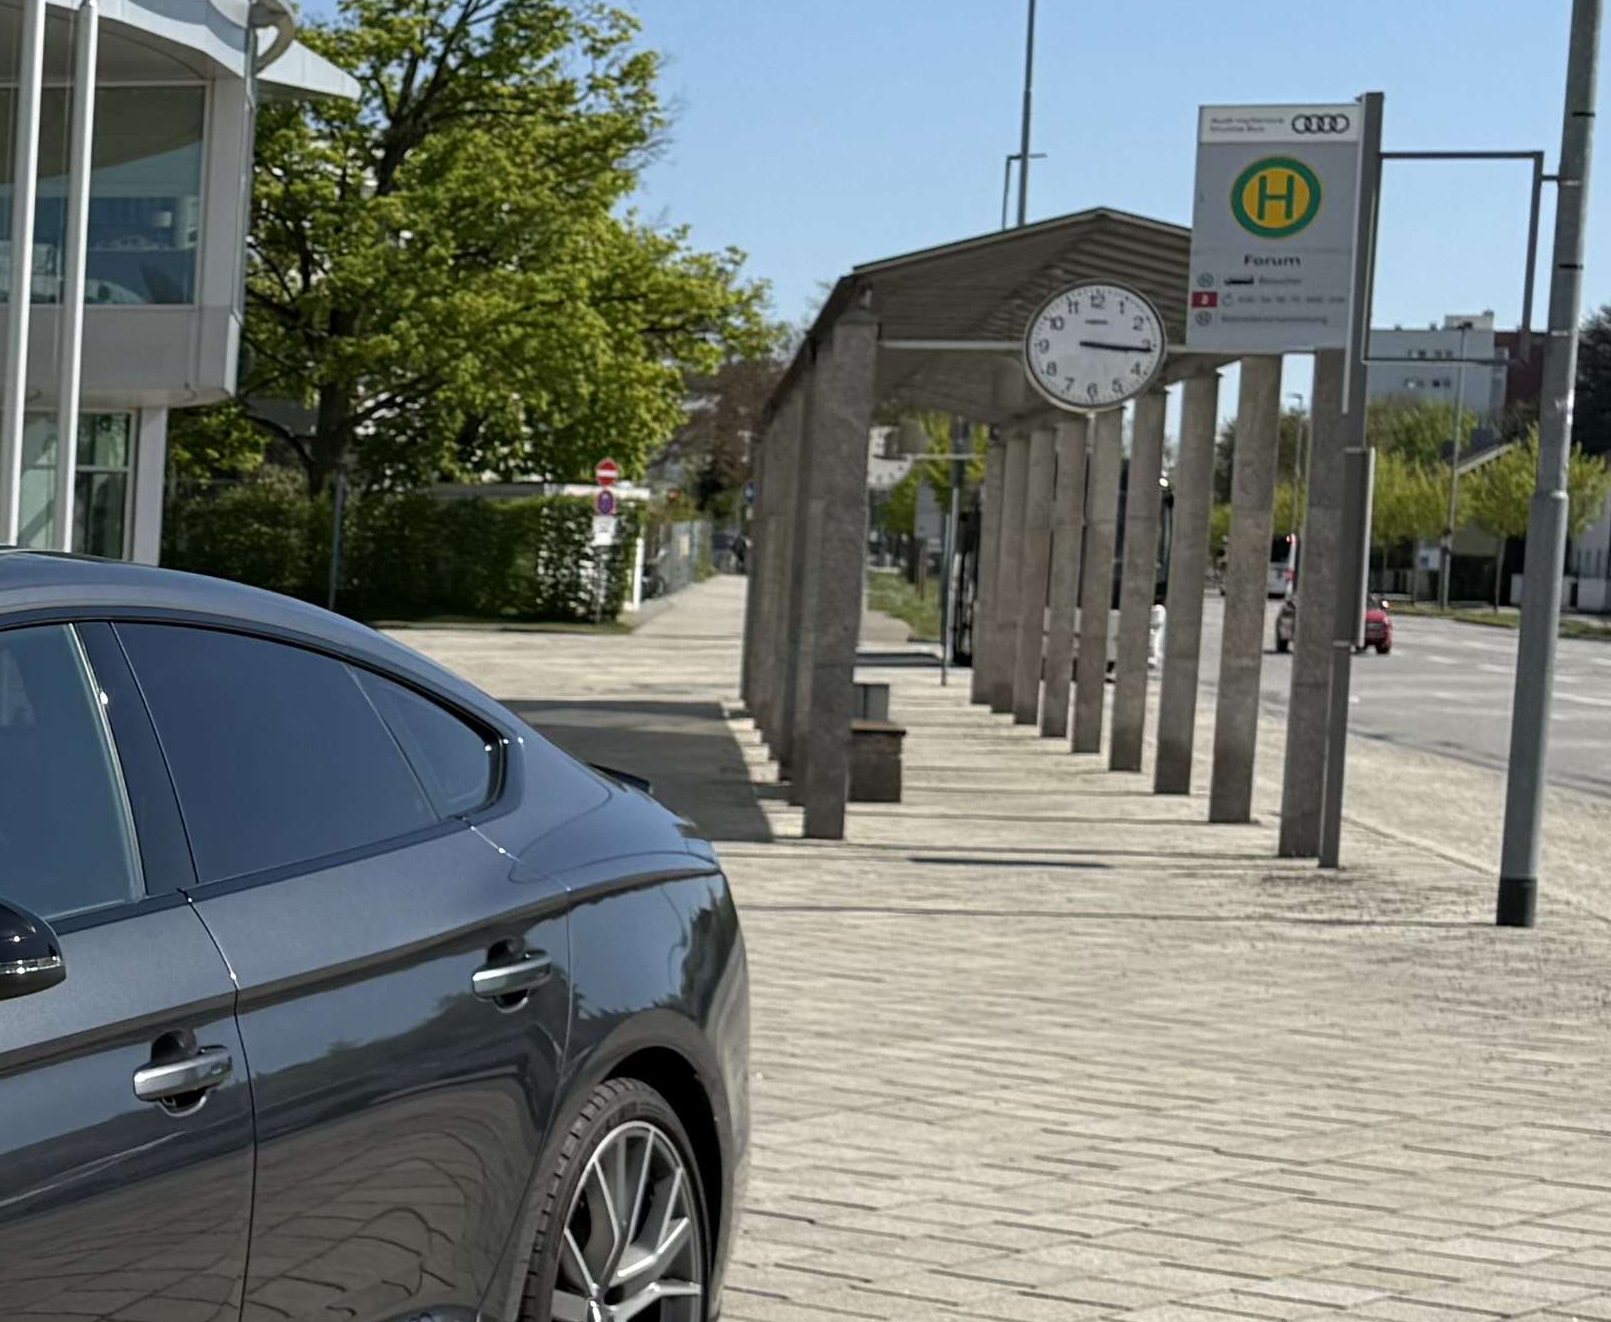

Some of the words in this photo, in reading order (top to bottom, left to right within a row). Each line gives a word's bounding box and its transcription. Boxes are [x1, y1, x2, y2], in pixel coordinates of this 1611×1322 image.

[1257, 175, 1295, 221] H
[1244, 254, 1301, 267] Forum
[1068, 300, 1079, 314] 11
[1090, 295, 1105, 309] 12
[1119, 300, 1125, 313] 1
[1050, 316, 1064, 330] 10
[1133, 316, 1143, 330] 2
[1039, 339, 1049, 353] 9
[1046, 362, 1057, 376] 8
[1131, 362, 1141, 375] 4
[1065, 378, 1075, 391] 7
[1087, 382, 1098, 398] 6
[1112, 378, 1123, 394] 5
